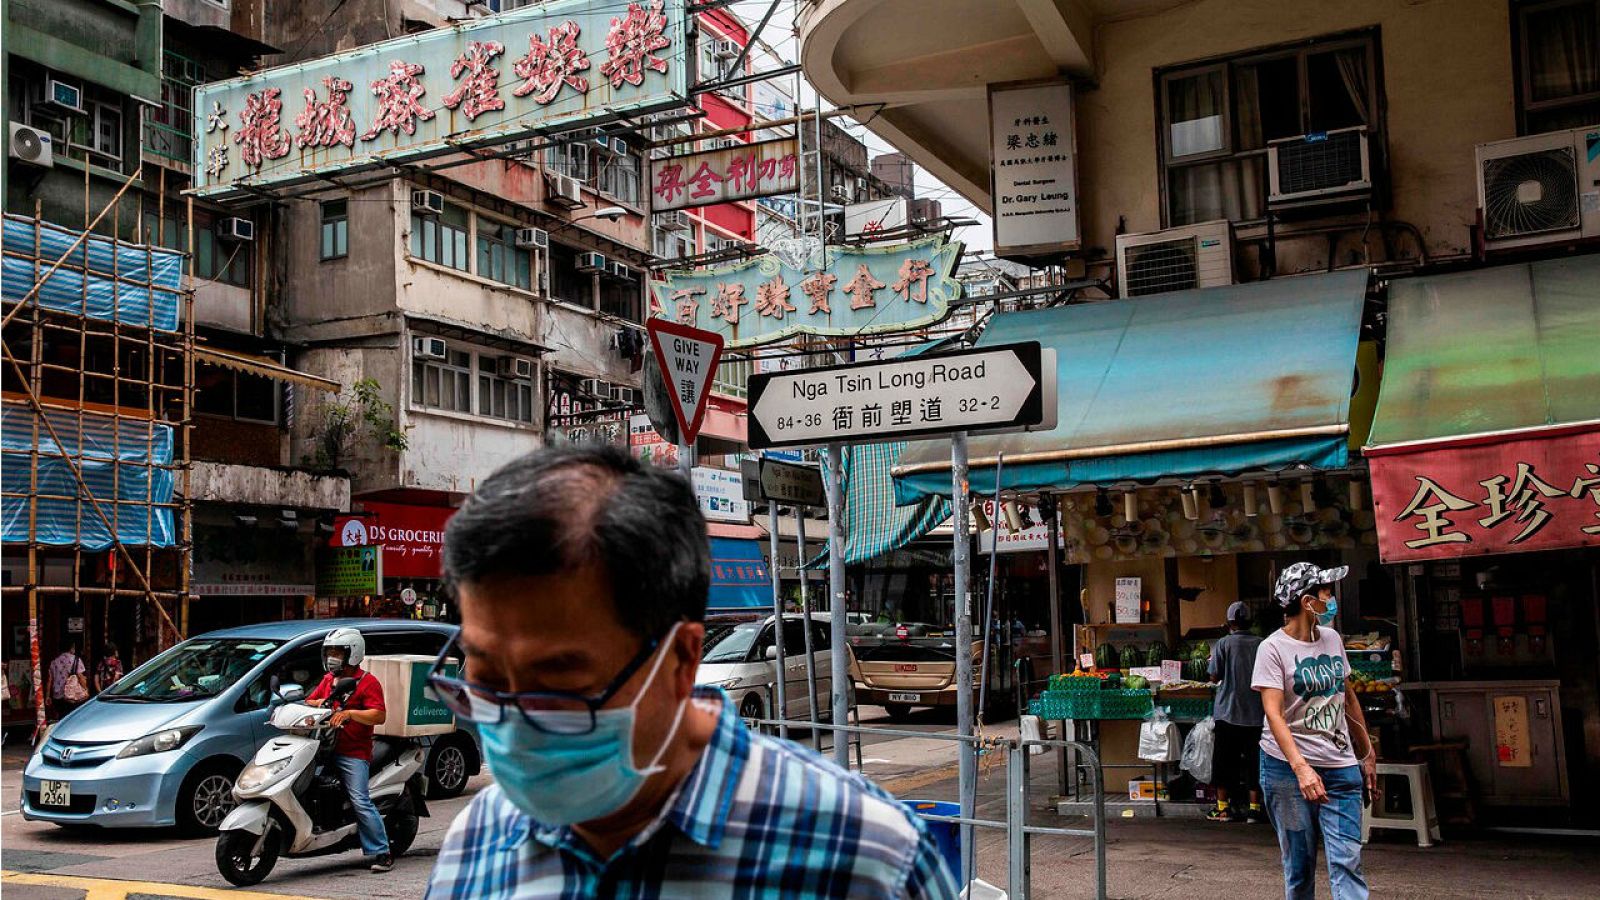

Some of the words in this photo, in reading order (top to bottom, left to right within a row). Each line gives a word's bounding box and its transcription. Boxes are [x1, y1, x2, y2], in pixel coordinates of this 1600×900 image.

[233, 0, 671, 169] 龍城麻雀娛樂
[1002, 195, 1015, 204] Dr.
[1016, 194, 1038, 203] Gary
[1041, 191, 1069, 201] Leung
[671, 259, 936, 328] 百好珠寶金行
[673, 338, 700, 357] GIVE
[674, 357, 700, 375] WAY
[792, 380, 828, 400] Nga
[835, 373, 872, 394] Tsin
[878, 370, 926, 390] Long
[932, 360, 987, 383] Road
[681, 379, 696, 404] 讓
[369, 525, 386, 540] DS
[413, 705, 449, 716] deliveroo
[1304, 703, 1341, 730] OKAY
[49, 780, 62, 792] UP
[44, 792, 66, 805] 2361
